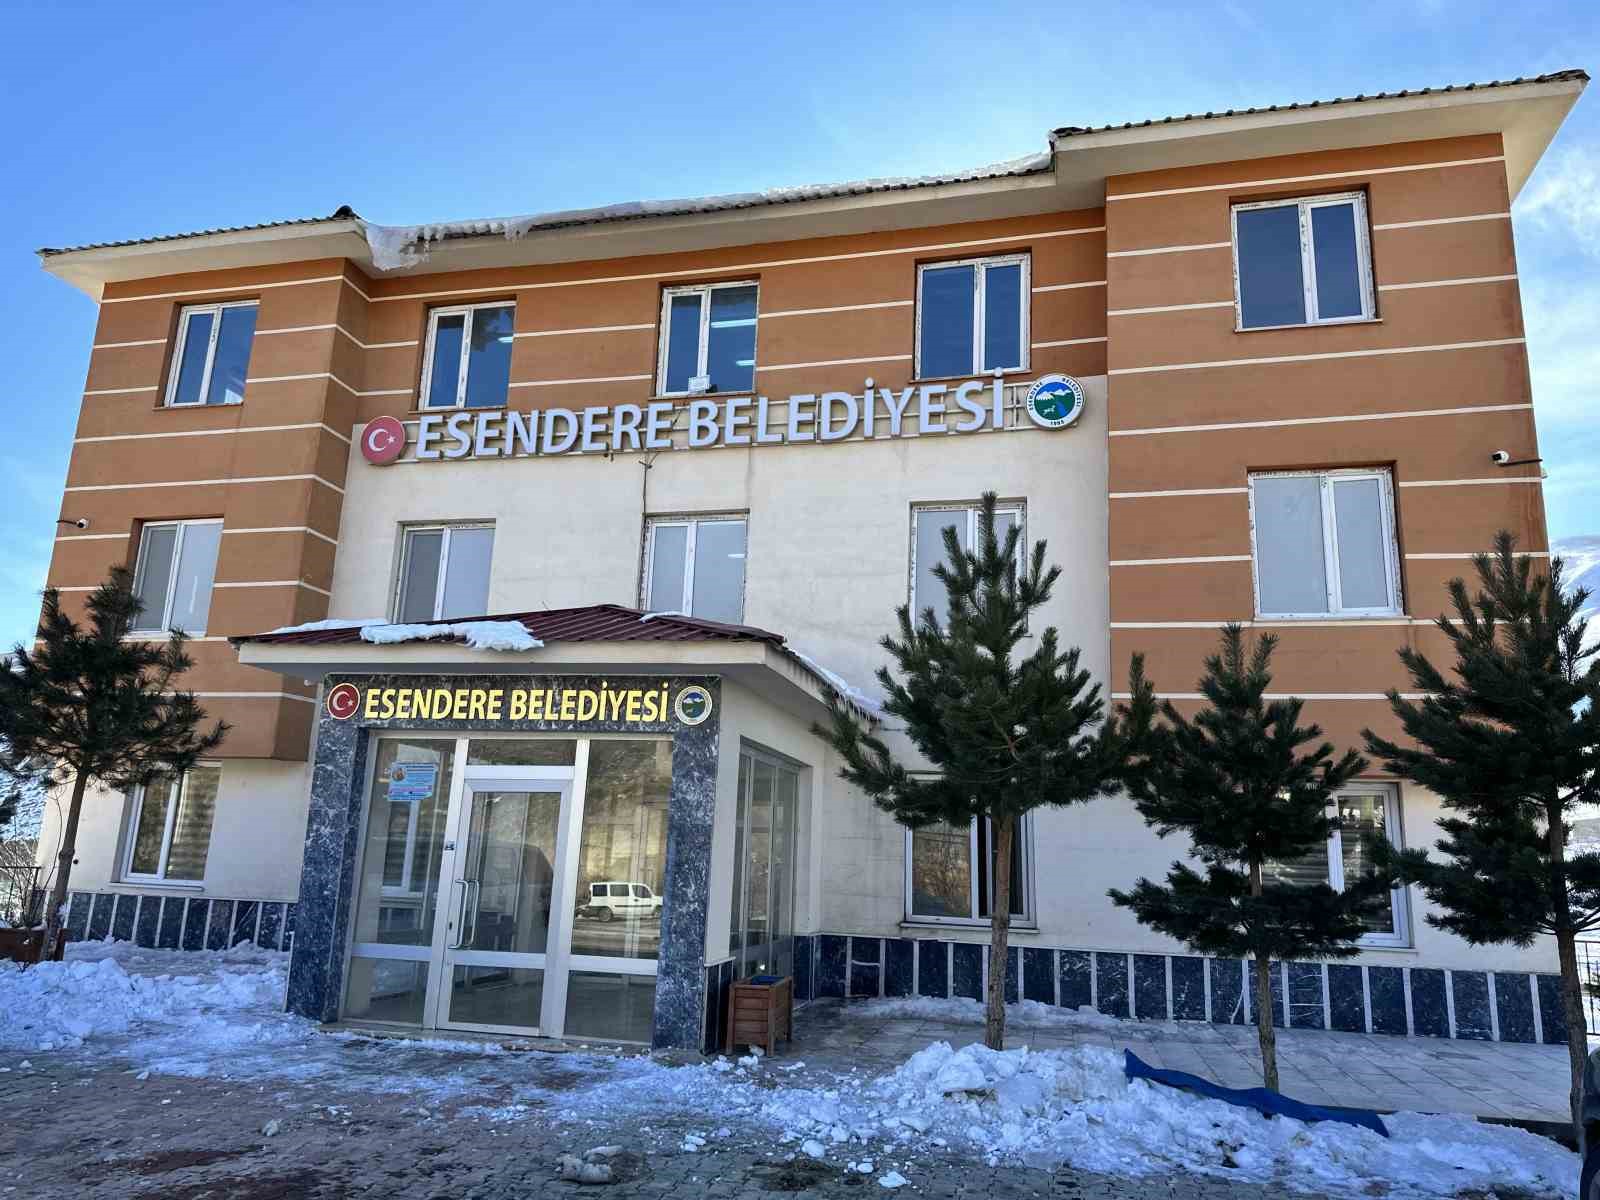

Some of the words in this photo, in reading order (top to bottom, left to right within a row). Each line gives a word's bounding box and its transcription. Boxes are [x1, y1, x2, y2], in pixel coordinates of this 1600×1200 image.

[416, 402, 674, 459] ESENDERE
[688, 366, 1005, 447] BELEDİYESİ
[364, 688, 503, 720] ESENDERE
[509, 682, 669, 722] BELEDİYESİ
